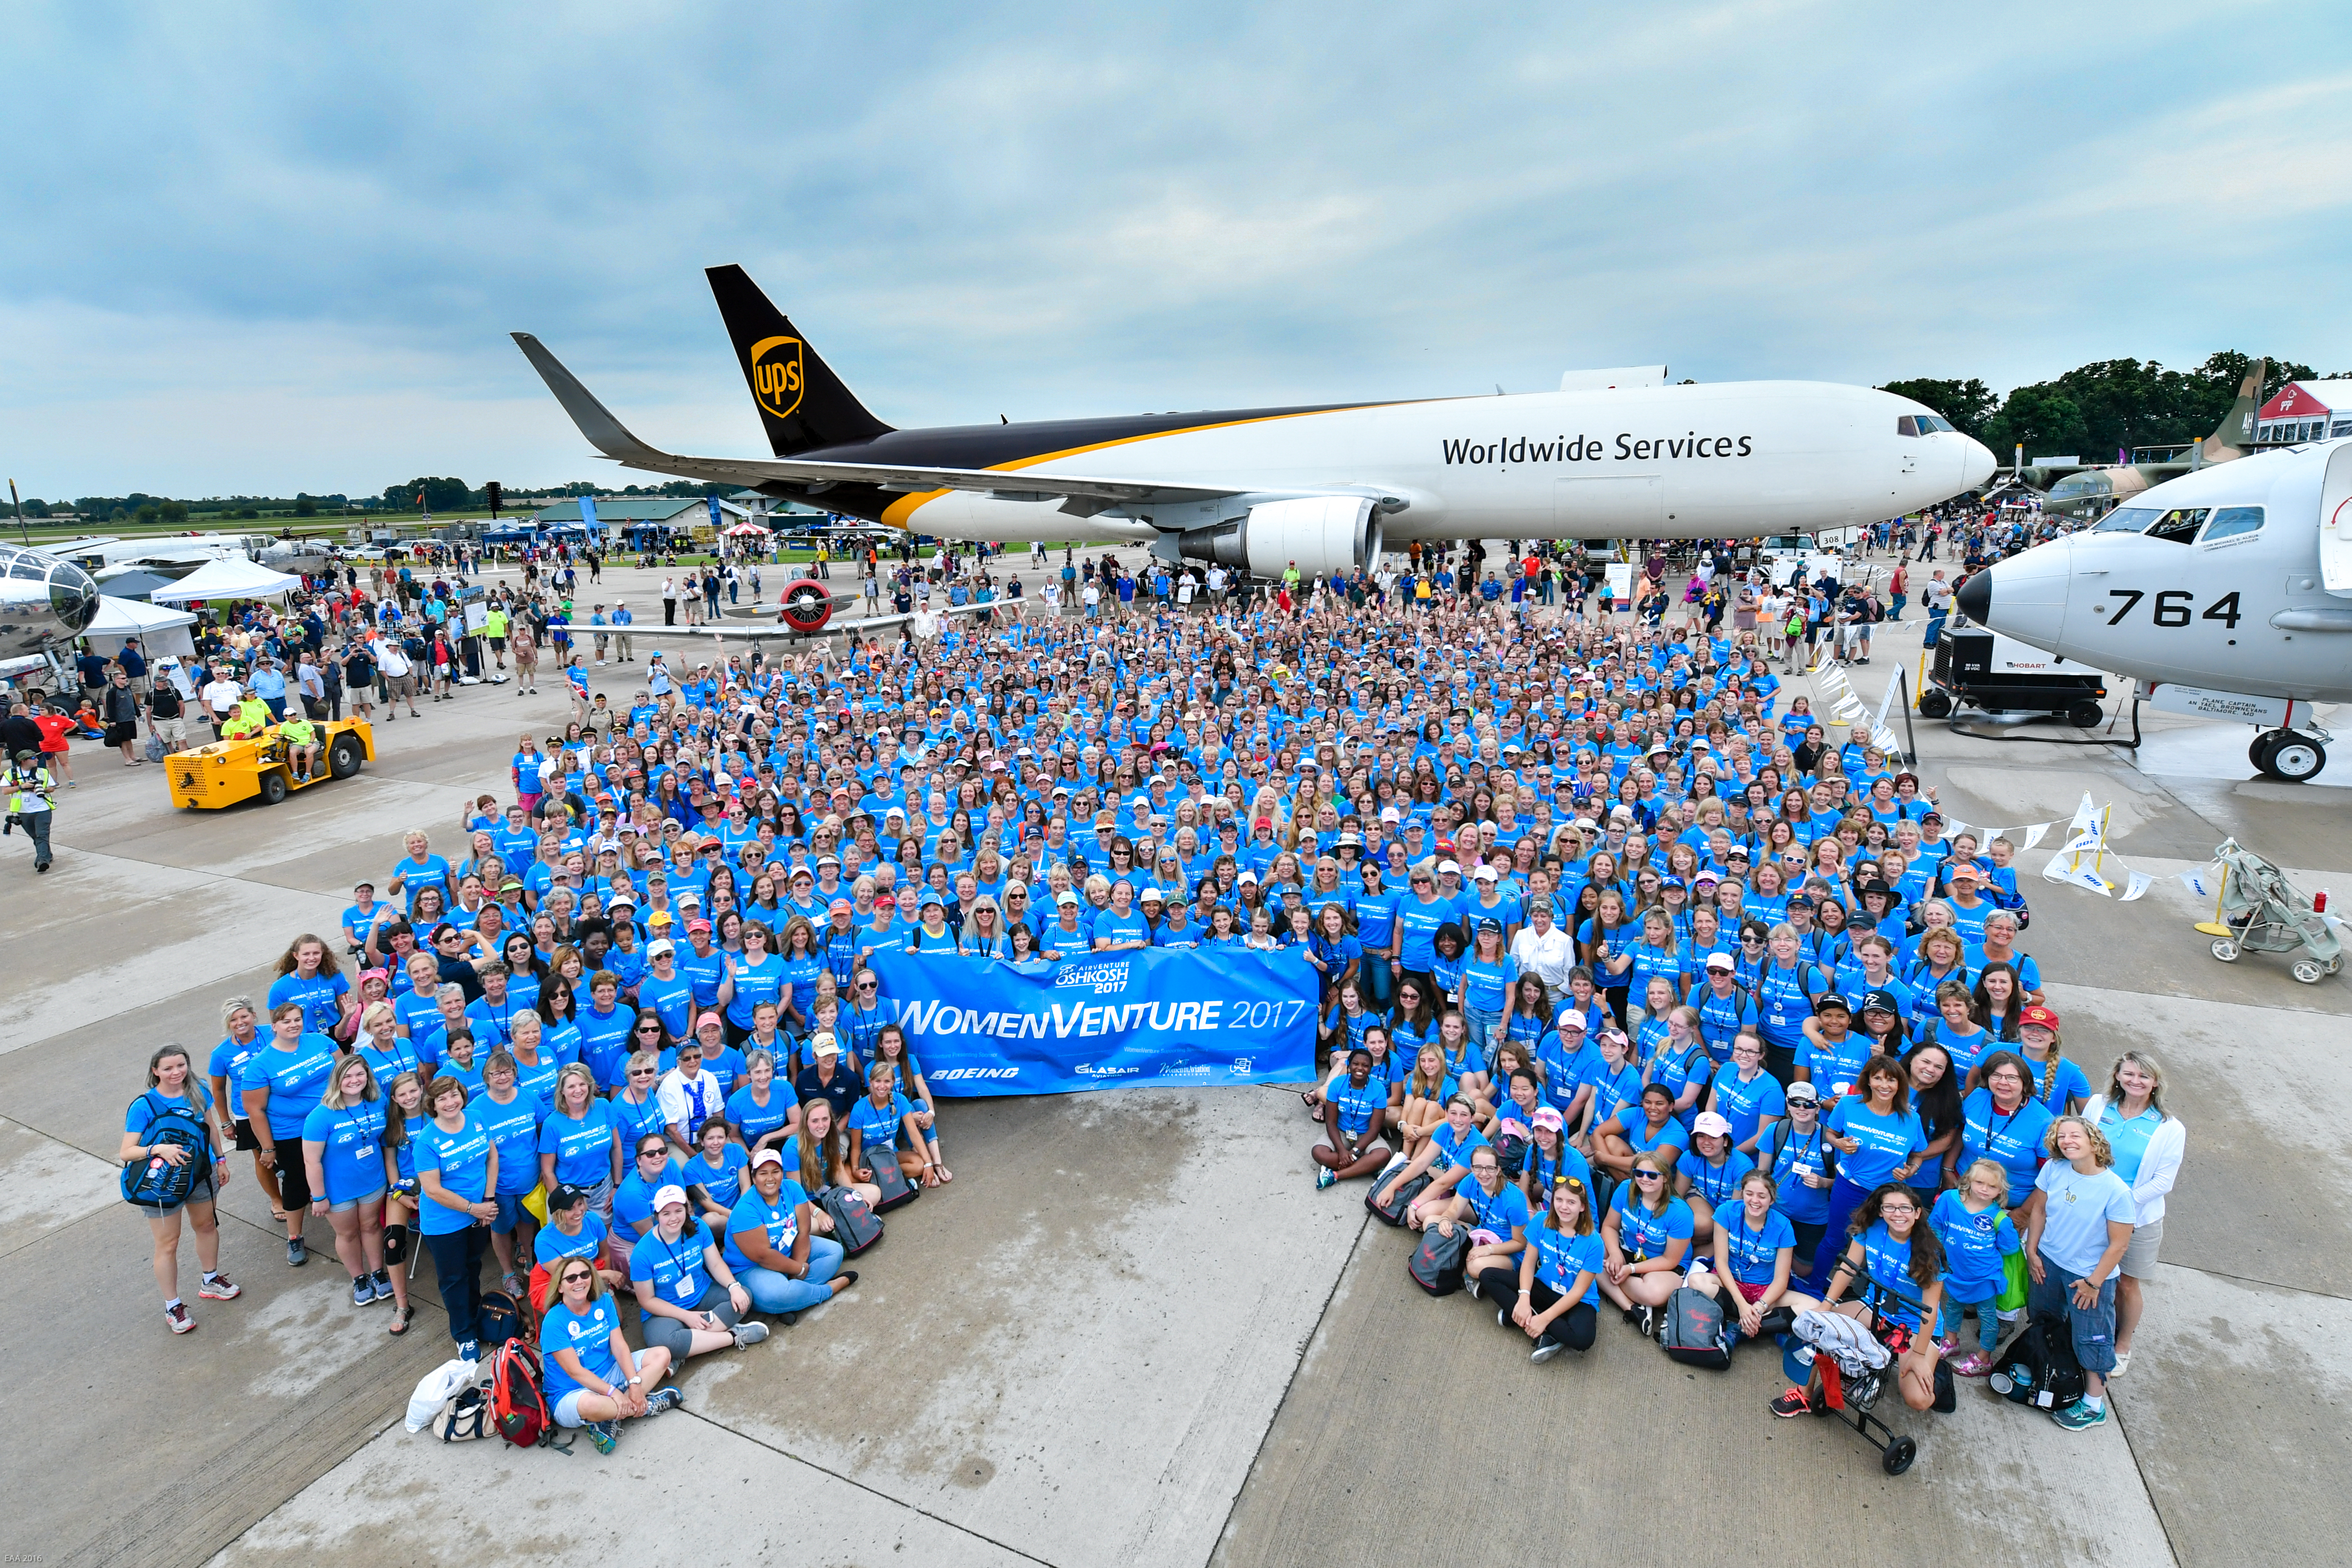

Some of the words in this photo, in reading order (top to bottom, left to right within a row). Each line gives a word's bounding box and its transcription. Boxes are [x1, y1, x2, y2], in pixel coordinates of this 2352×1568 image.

[757, 360, 800, 405] ups
[1442, 434, 1603, 465] Worldwide
[1614, 431, 1752, 460] Services
[1824, 536, 1839, 544] 308
[2204, 543, 2237, 553] COMMANDING
[2107, 589, 2241, 629] 764
[2220, 705, 2267, 714] BROWNEVANS
[2083, 874, 2102, 886] 100
[2193, 879, 2207, 896] 100
[1078, 961, 1130, 971] AIRVENTURE
[1054, 970, 1129, 985] OSHKOSH
[1094, 981, 1128, 994] 2017
[1228, 1000, 1305, 1029] 2017
[277, 1055, 319, 1076] WOMENVENTURE
[314, 1060, 333, 1070] BOEING
[520, 1072, 552, 1087] WOMENVENTURE
[929, 1067, 1019, 1080] BOEING
[285, 1079, 299, 1087] EAA
[560, 1126, 599, 1143] WOMENVENTURE
[1847, 1121, 1895, 1139] WOMENVENTURE
[338, 1135, 353, 1143] EAA
[593, 1136, 611, 1145] BOEING
[2007, 1136, 2022, 1146] 2017
[439, 1138, 479, 1158] WOMENVENTURE
[565, 1149, 578, 1157] EAA
[1878, 1145, 1904, 1155] BOEING
[691, 1245, 700, 1255] 2017
[685, 1258, 702, 1271] BOEING
